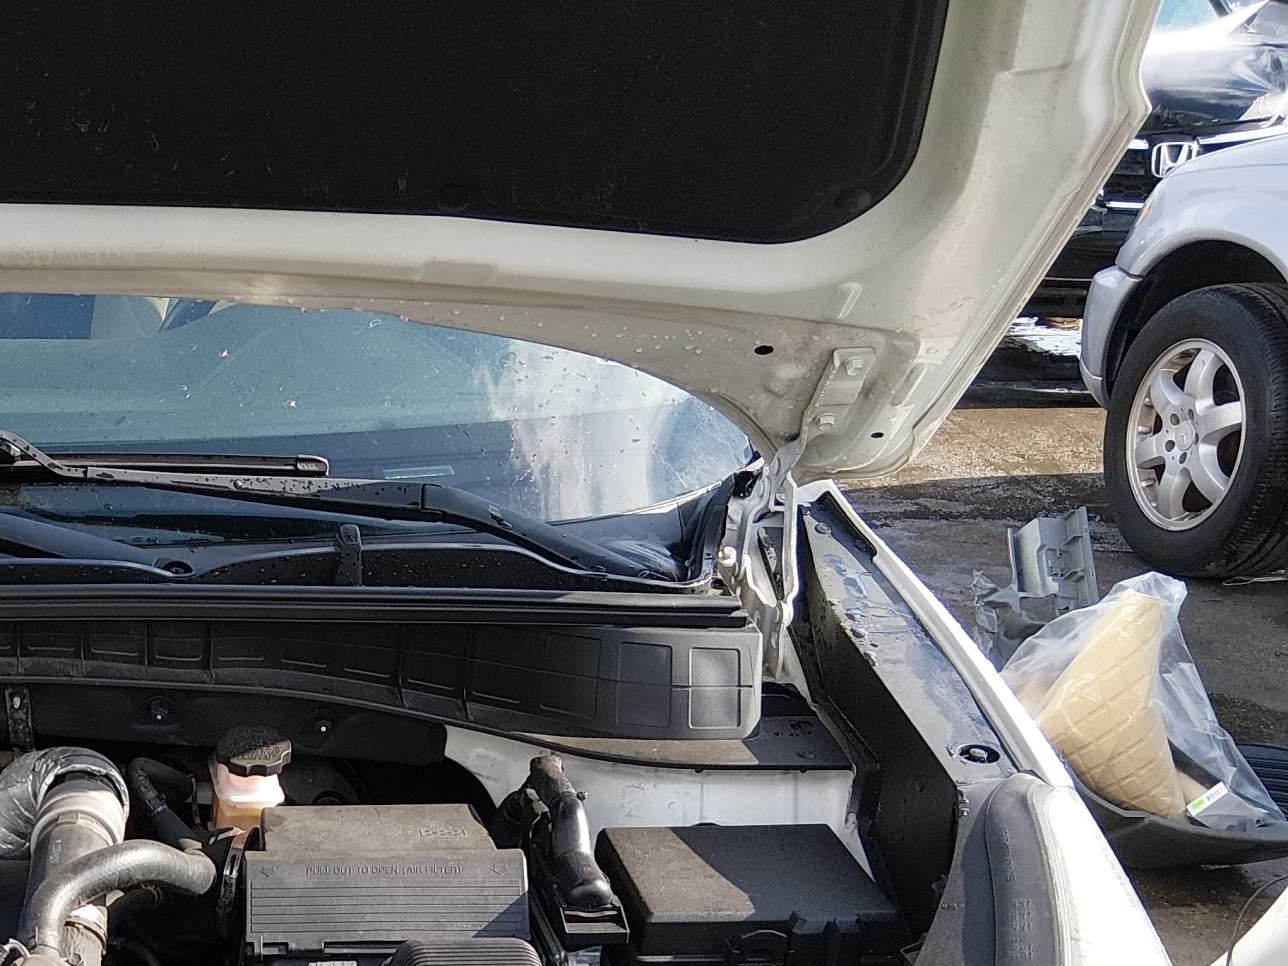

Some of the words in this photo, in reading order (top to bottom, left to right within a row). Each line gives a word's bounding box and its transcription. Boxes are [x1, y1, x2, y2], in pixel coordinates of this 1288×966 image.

[305, 865, 330, 876] PULL
[333, 865, 352, 875] OUT
[355, 865, 369, 875] TO
[371, 865, 400, 875] OPEN
